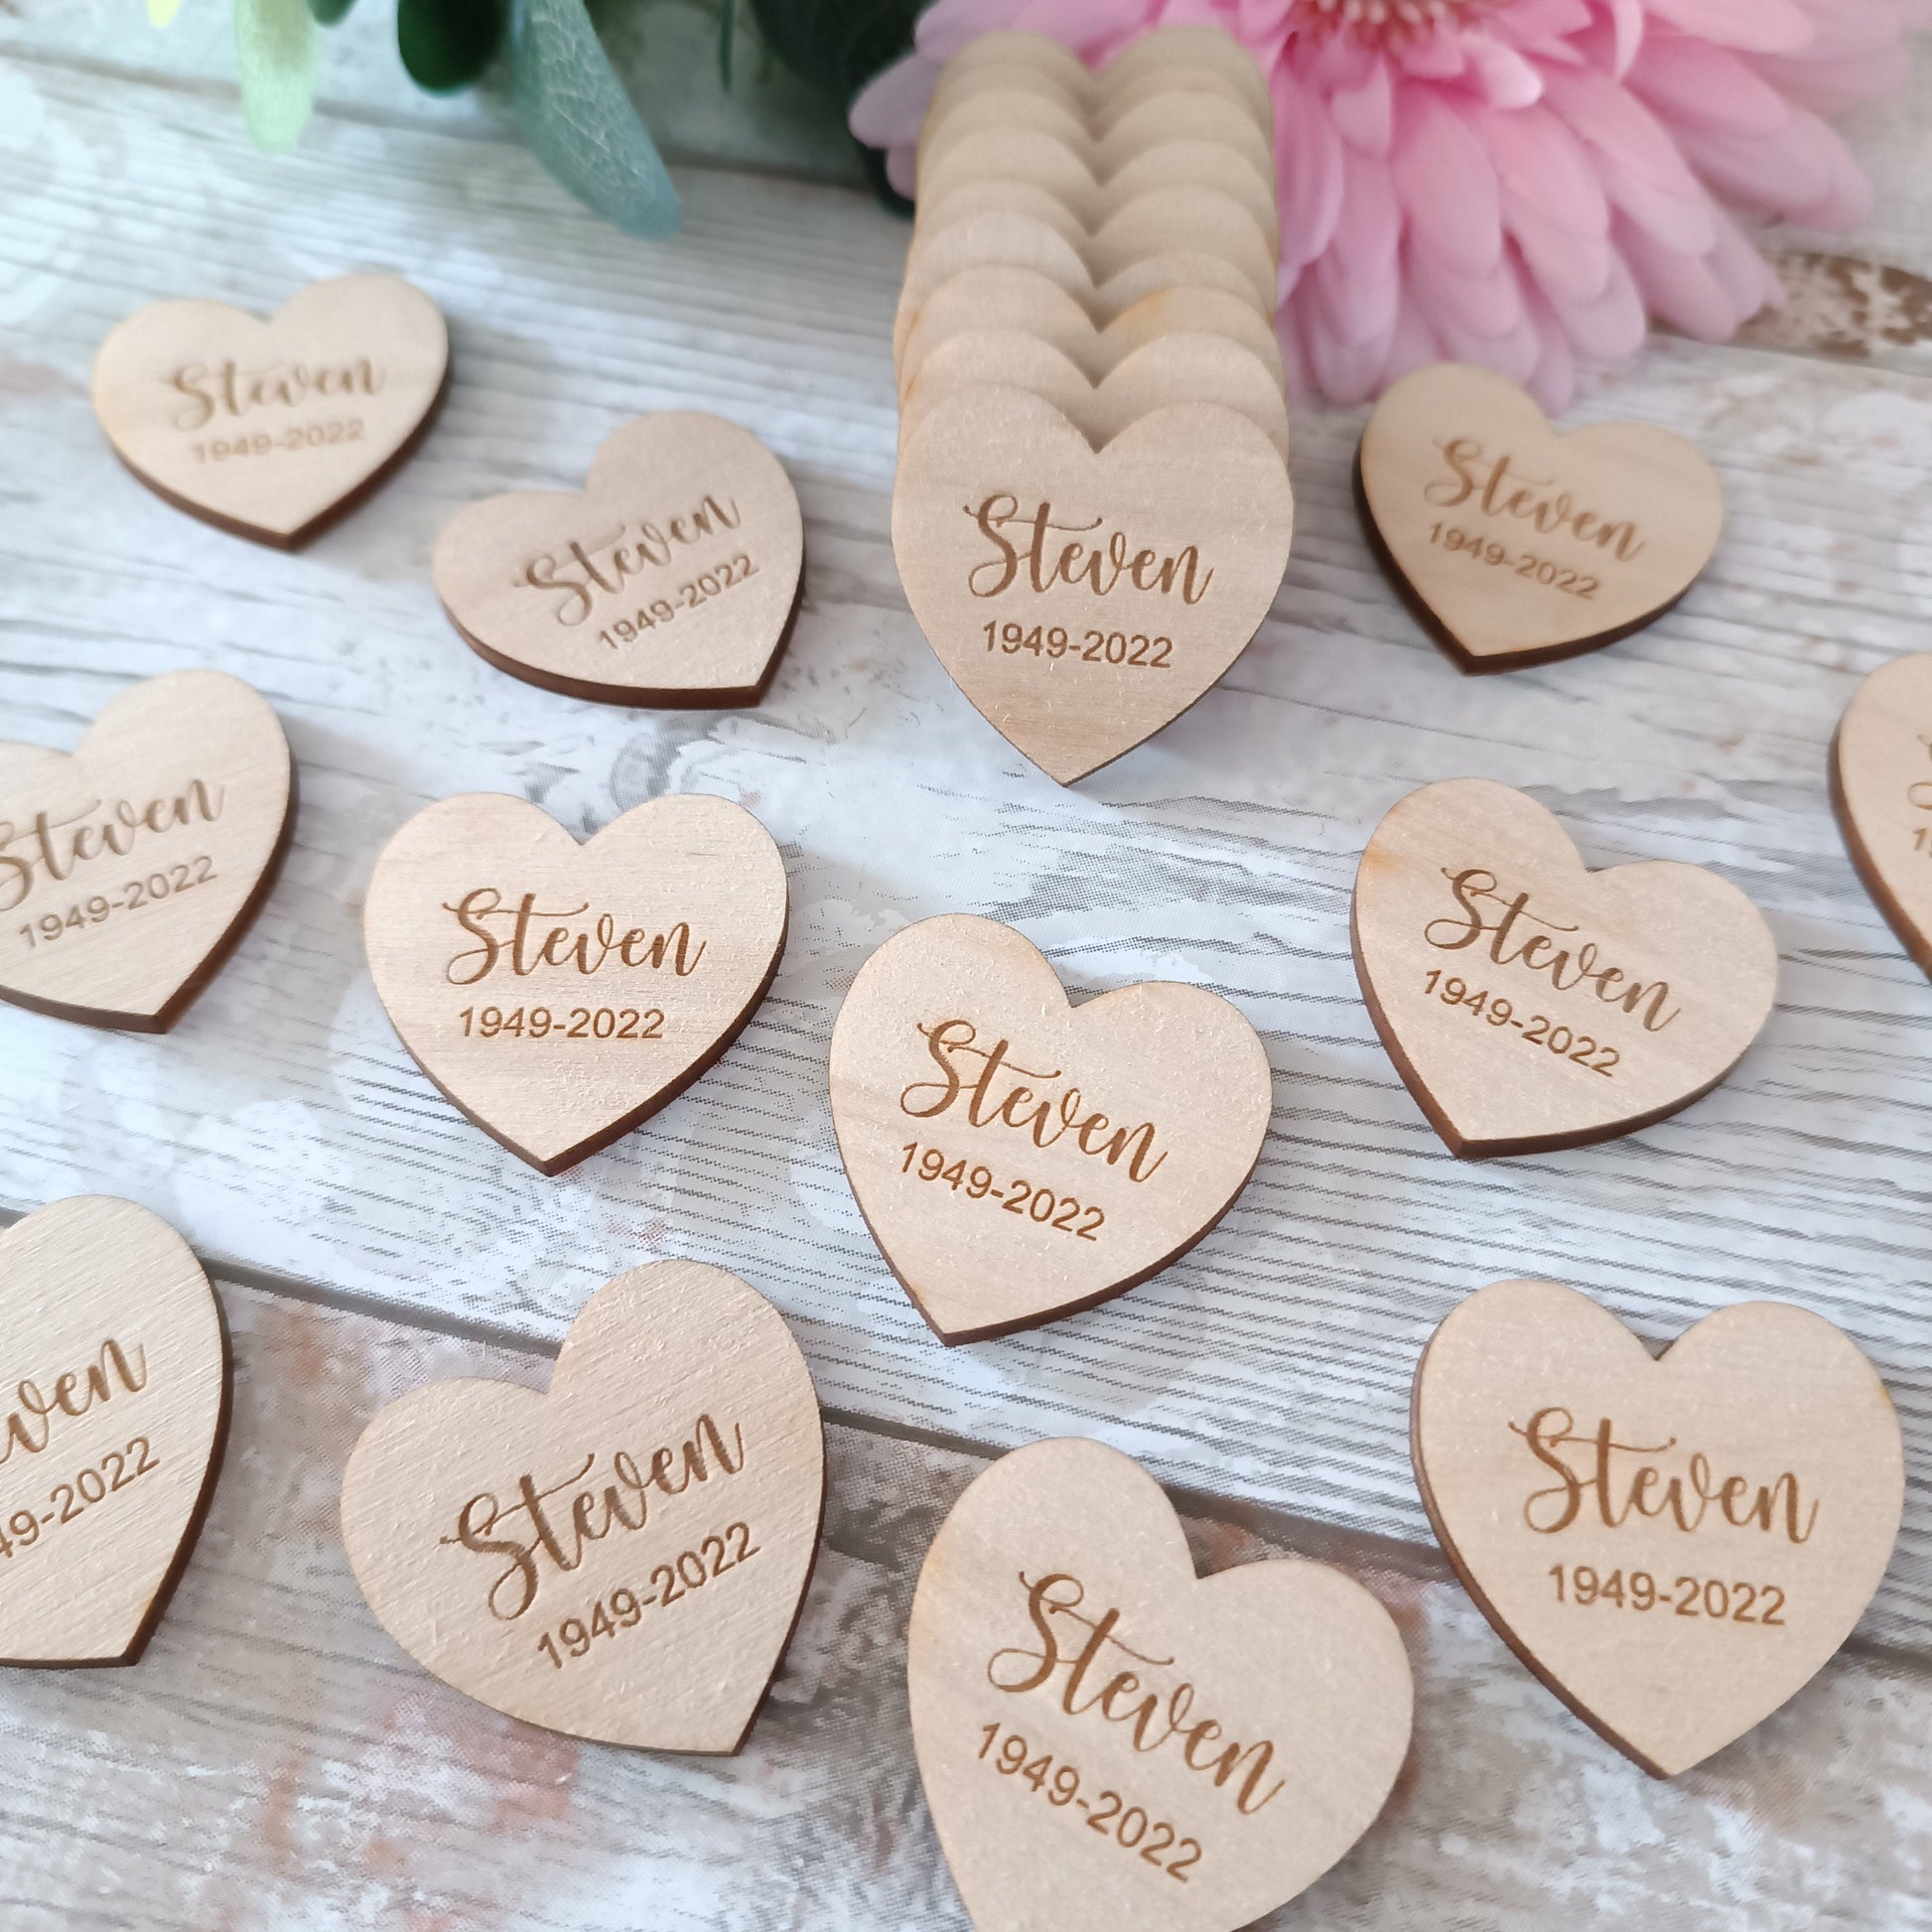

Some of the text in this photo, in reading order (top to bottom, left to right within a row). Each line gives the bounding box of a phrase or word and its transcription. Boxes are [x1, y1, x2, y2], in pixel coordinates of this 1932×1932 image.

[165, 351, 388, 433] Steven
[191, 418, 367, 467] 1949-2022
[963, 493, 1214, 607] Steven
[1424, 436, 1648, 564] Steven
[512, 493, 744, 628] Steven
[598, 554, 761, 653] 1949-2022
[1428, 520, 1601, 602] 1949-2022
[982, 619, 1174, 670] 1949-2022
[18, 855, 218, 948] 1949-2022
[441, 888, 708, 987] Steven
[1424, 867, 1682, 1034] Steven
[460, 1006, 666, 1040] 1949-2022
[1424, 969, 1622, 1080] 1949-2022
[899, 1019, 1170, 1184] Steven
[900, 1142, 1107, 1242] 1949-2022
[0, 1337, 148, 1464] ven
[439, 1413, 746, 1622] Steven
[1508, 1406, 1821, 1545] Steven
[536, 1520, 762, 1671] 1949-2022
[1547, 1564, 1788, 1626] 1949-2022
[987, 1570, 1286, 1816] Steven
[978, 1722, 1205, 1884] 1949-2022
